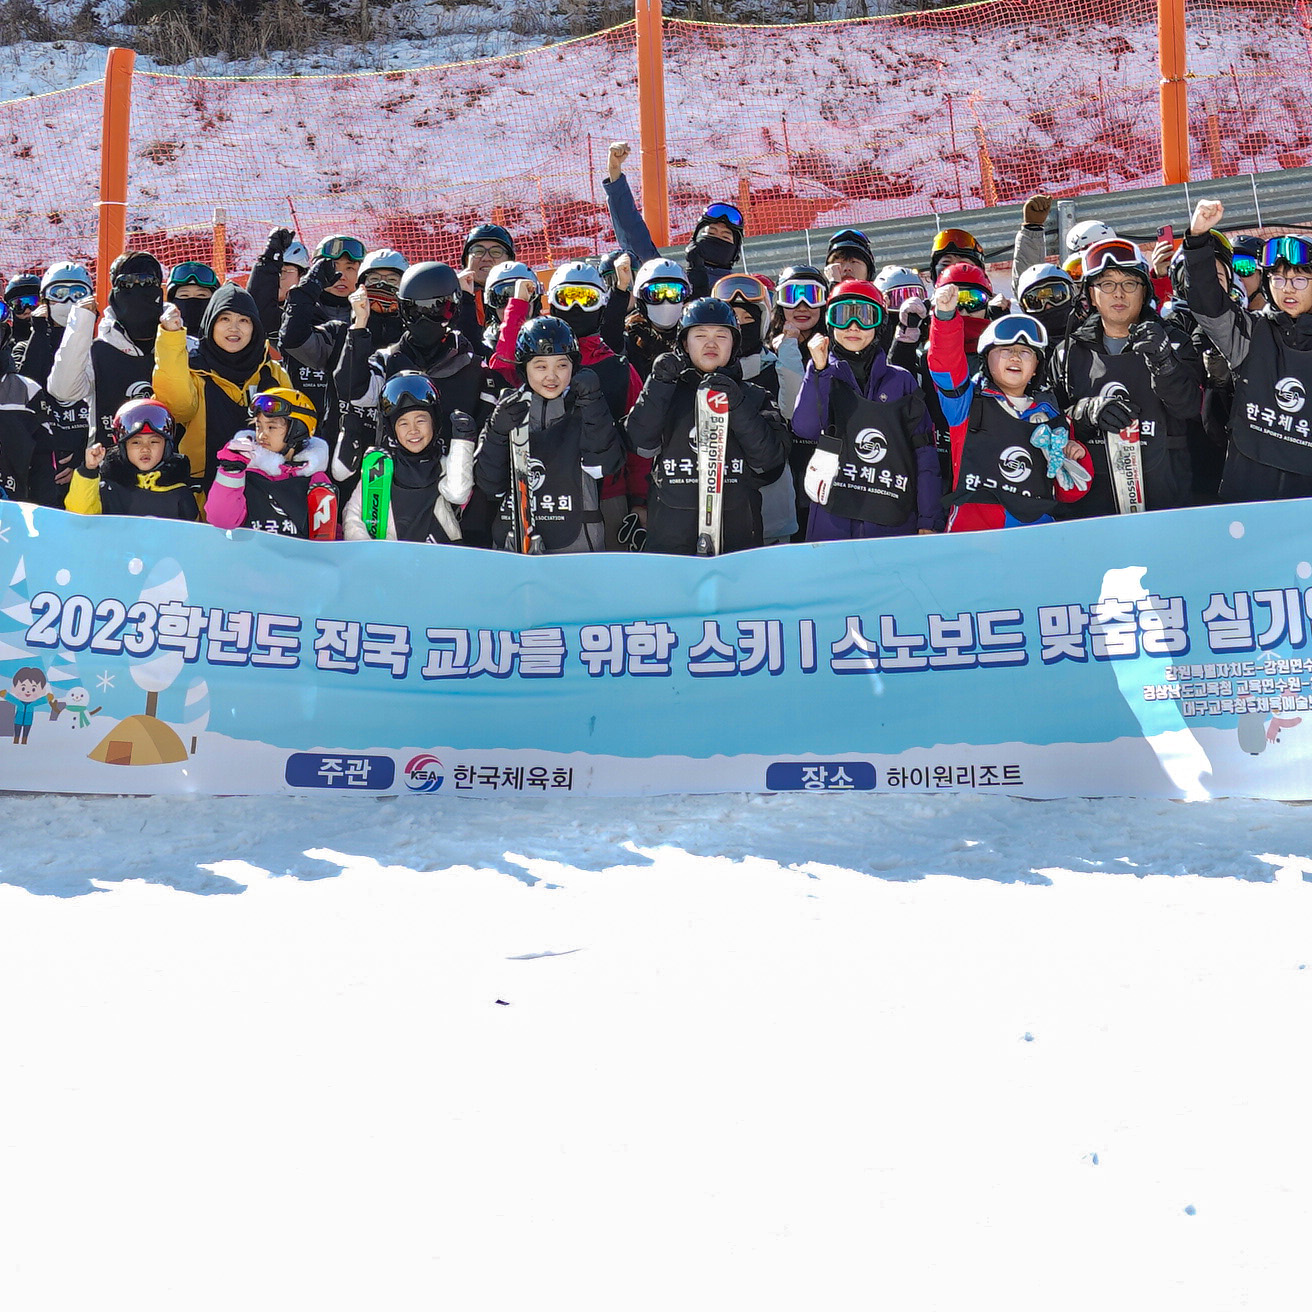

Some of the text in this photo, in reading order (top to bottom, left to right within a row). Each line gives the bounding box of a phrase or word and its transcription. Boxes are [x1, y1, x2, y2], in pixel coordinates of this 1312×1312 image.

[662, 459, 744, 476] 한국회
[707, 425, 719, 494] ROSSIGNOL
[837, 461, 909, 493] 국체육회
[1124, 453, 1137, 505] ROSSIGNOL
[847, 483, 867, 492] SPORTS
[867, 487, 899, 499] ASSOCIATION
[26, 590, 303, 669] 2023학년도
[313, 616, 411, 679] 전국
[421, 625, 567, 679] 교사를
[579, 620, 678, 676] 위한
[688, 619, 786, 676] 스키
[830, 608, 1029, 674] 스노보드
[1036, 593, 1190, 665] 맞춤형
[1143, 681, 1233, 701] 경상남도교육청
[317, 758, 372, 786] 주관
[453, 764, 574, 791] 한국체육회
[801, 766, 855, 790] 장소
[886, 764, 1024, 789] 하이원리조트
